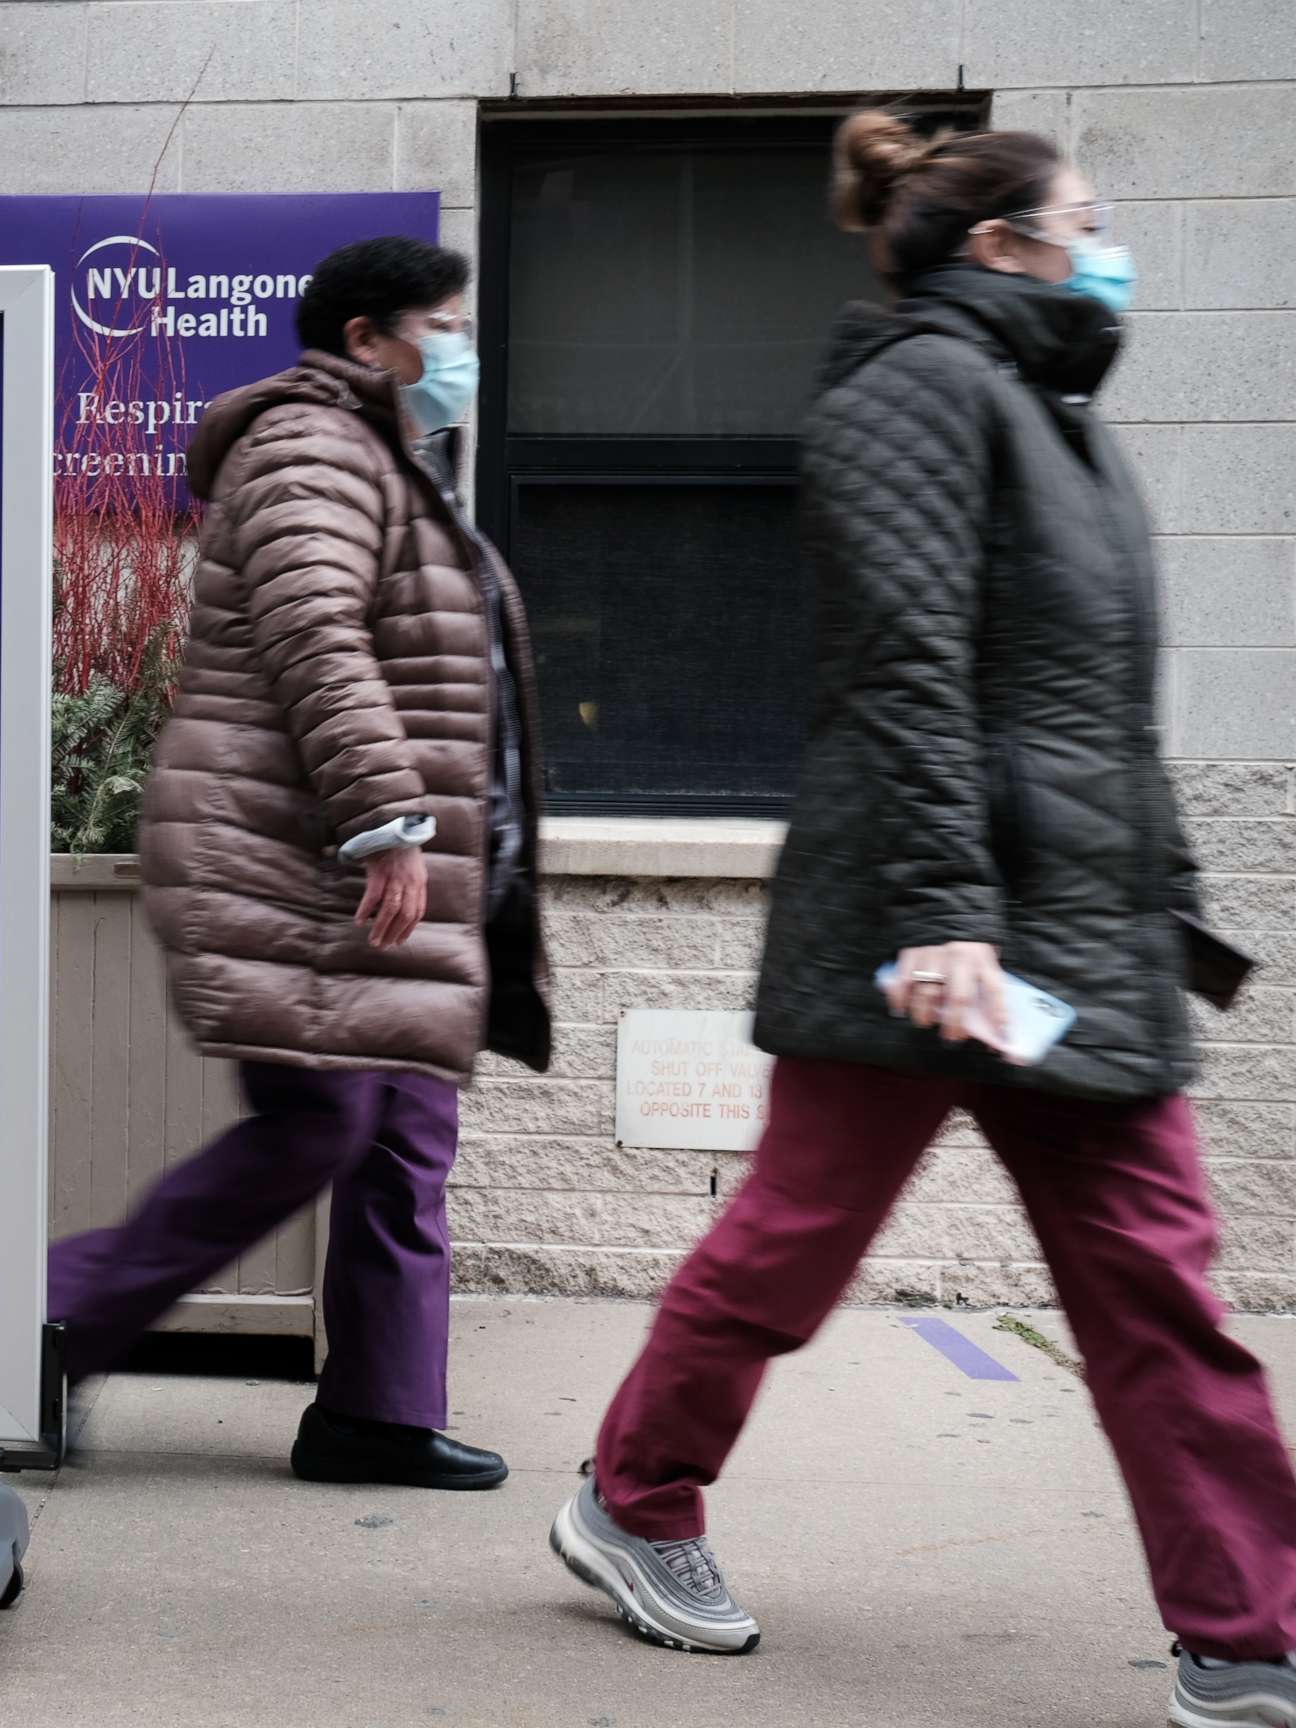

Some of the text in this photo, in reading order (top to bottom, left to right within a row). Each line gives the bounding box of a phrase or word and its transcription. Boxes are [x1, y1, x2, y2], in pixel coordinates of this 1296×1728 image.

[88, 267, 161, 299] NYU
[151, 304, 267, 337] Health
[650, 1059, 689, 1076] SHUT
[695, 1061, 723, 1077] OFF
[626, 1080, 692, 1096] LOCATED
[697, 1082, 706, 1097] 7
[712, 1083, 742, 1098] AND
[640, 1101, 712, 1118] OPPOSITE
[719, 1103, 750, 1119] THIS
